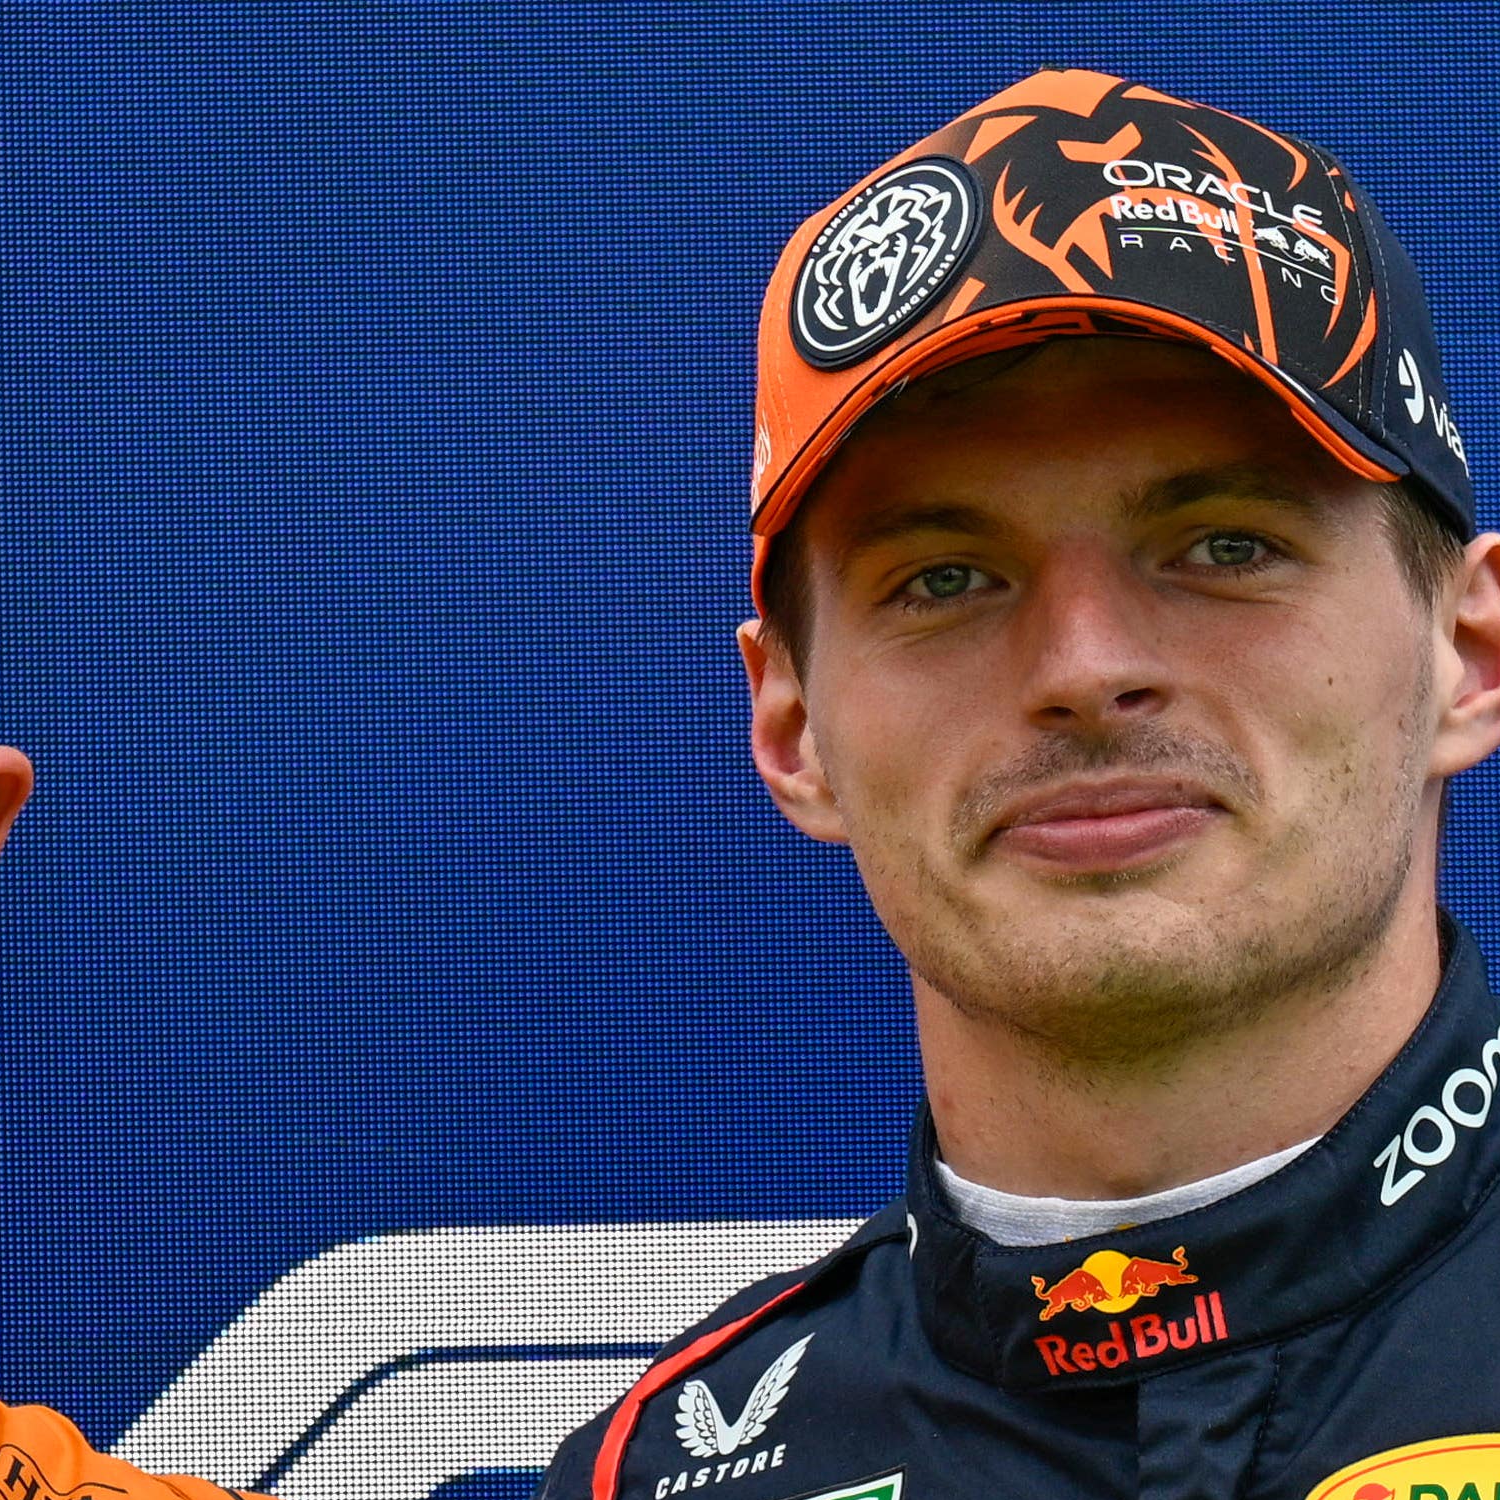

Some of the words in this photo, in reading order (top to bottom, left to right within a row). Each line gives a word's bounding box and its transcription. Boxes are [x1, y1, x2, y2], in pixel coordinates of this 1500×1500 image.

[1103, 159, 1327, 236] ORACLE
[1109, 194, 1178, 222] Red
[1178, 199, 1240, 235] Bull
[1428, 394, 1471, 479] via
[1033, 1329, 1125, 1377] Red
[1130, 1290, 1229, 1359] Bull
[653, 1441, 788, 1500] CASTORE
